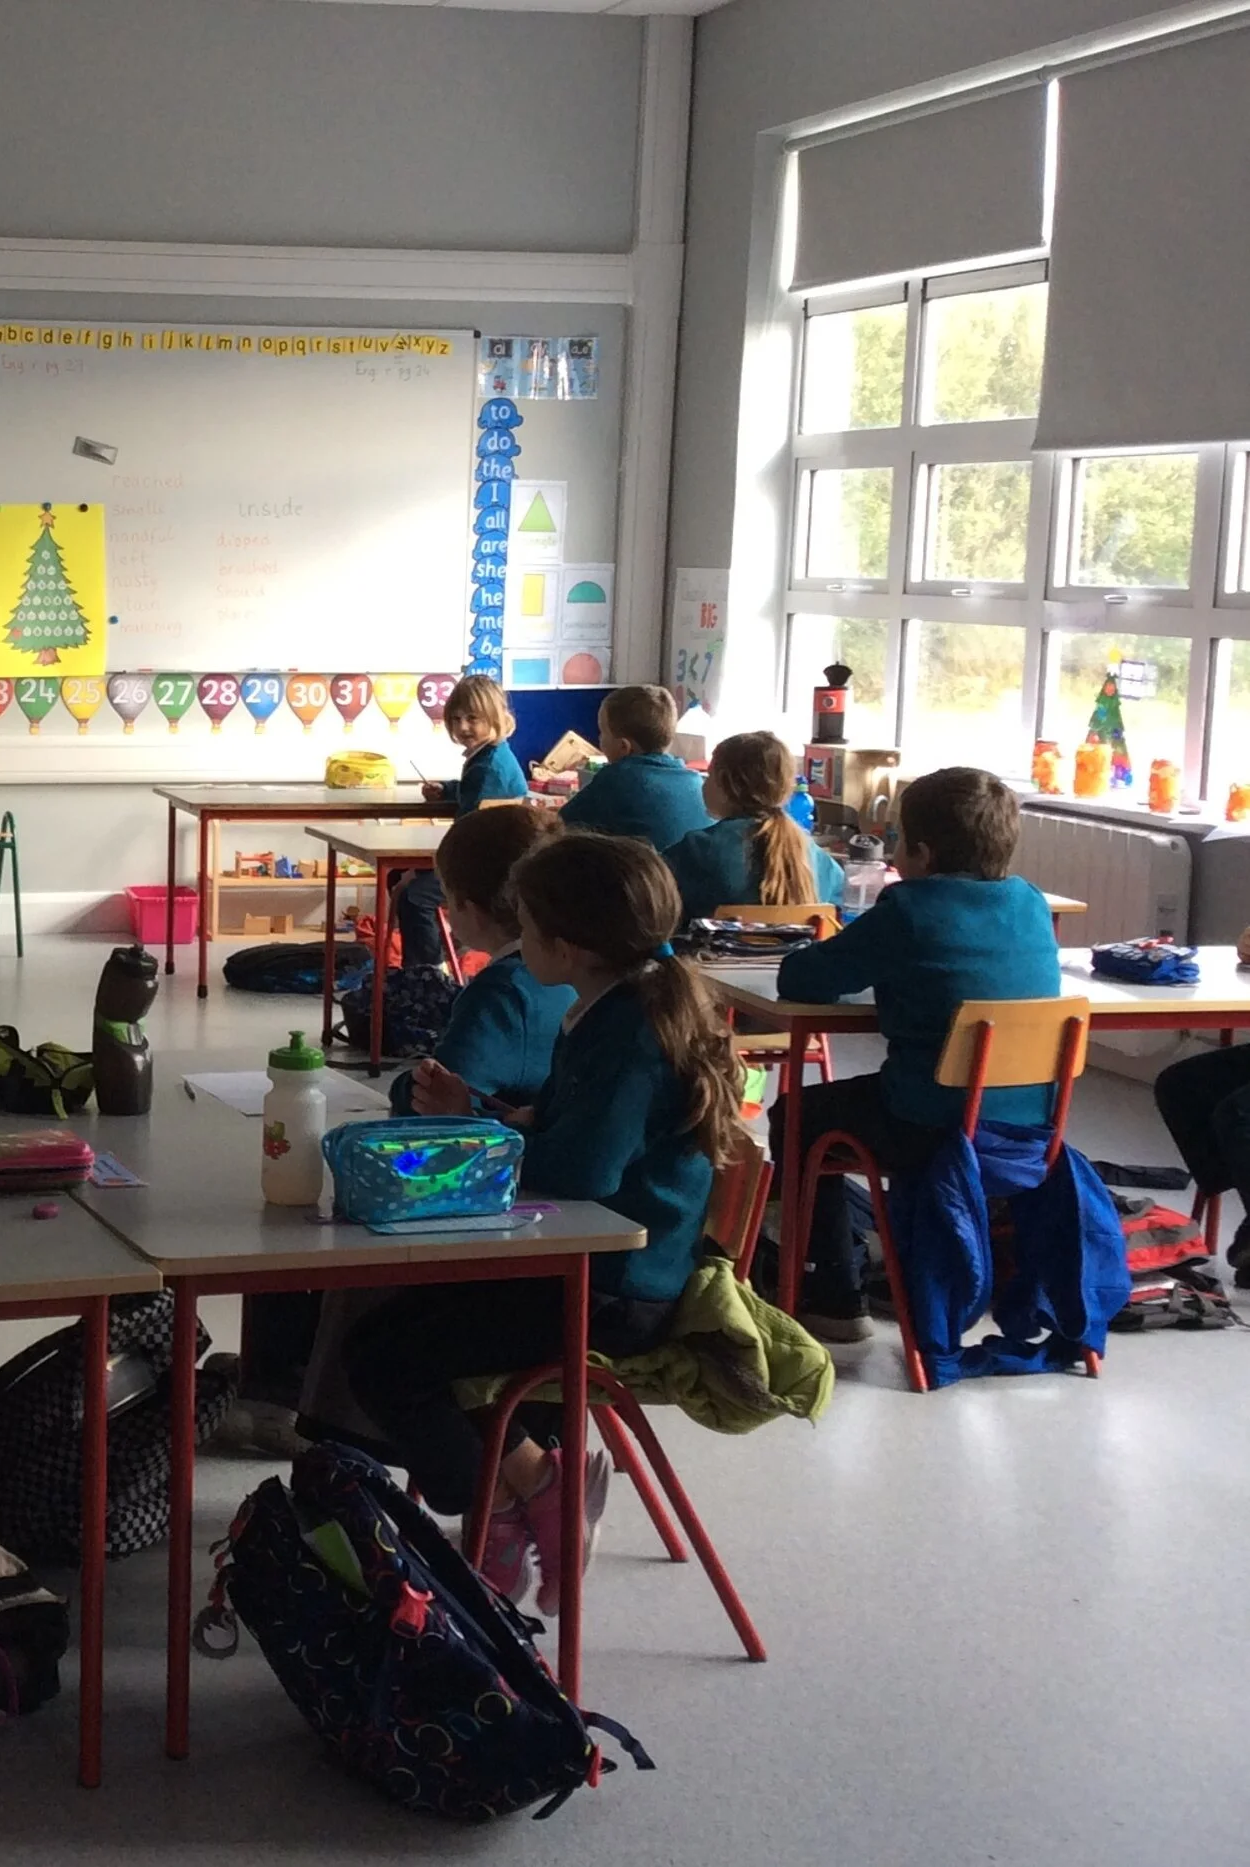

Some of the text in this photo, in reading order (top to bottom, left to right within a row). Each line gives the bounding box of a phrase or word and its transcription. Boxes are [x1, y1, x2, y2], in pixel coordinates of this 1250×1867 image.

[8, 326, 17, 339] b
[25, 330, 34, 343] c
[43, 330, 53, 344] d
[62, 332, 72, 345] e
[83, 331, 92, 345] f
[102, 334, 112, 349] g
[122, 333, 132, 347] h
[184, 334, 193, 348] k
[219, 338, 232, 349] m
[242, 337, 251, 348] n
[262, 338, 272, 349] o
[279, 341, 288, 355] p
[296, 340, 306, 355] q
[316, 339, 323, 350] r
[332, 341, 341, 353] s
[349, 339, 354, 353] t
[363, 337, 373, 349] u
[379, 341, 389, 352] v
[413, 336, 421, 347] x
[426, 340, 435, 354] y
[439, 342, 448, 354] z
[490, 405, 510, 419] to
[487, 432, 511, 450] do
[483, 458, 512, 478] the
[491, 483, 499, 502] I
[238, 496, 304, 518] inside
[485, 512, 506, 528] all
[481, 540, 508, 554] are
[476, 560, 507, 577] she
[482, 588, 503, 606] he
[479, 615, 503, 628] me
[480, 637, 502, 659] be
[19, 679, 55, 703] 24
[67, 679, 101, 704] 25
[114, 679, 147, 704] 26
[158, 680, 193, 705] 27
[202, 680, 237, 705] 28
[246, 679, 279, 703] 29
[292, 682, 327, 707] 30
[336, 680, 368, 705] 31
[421, 682, 452, 707] 33
